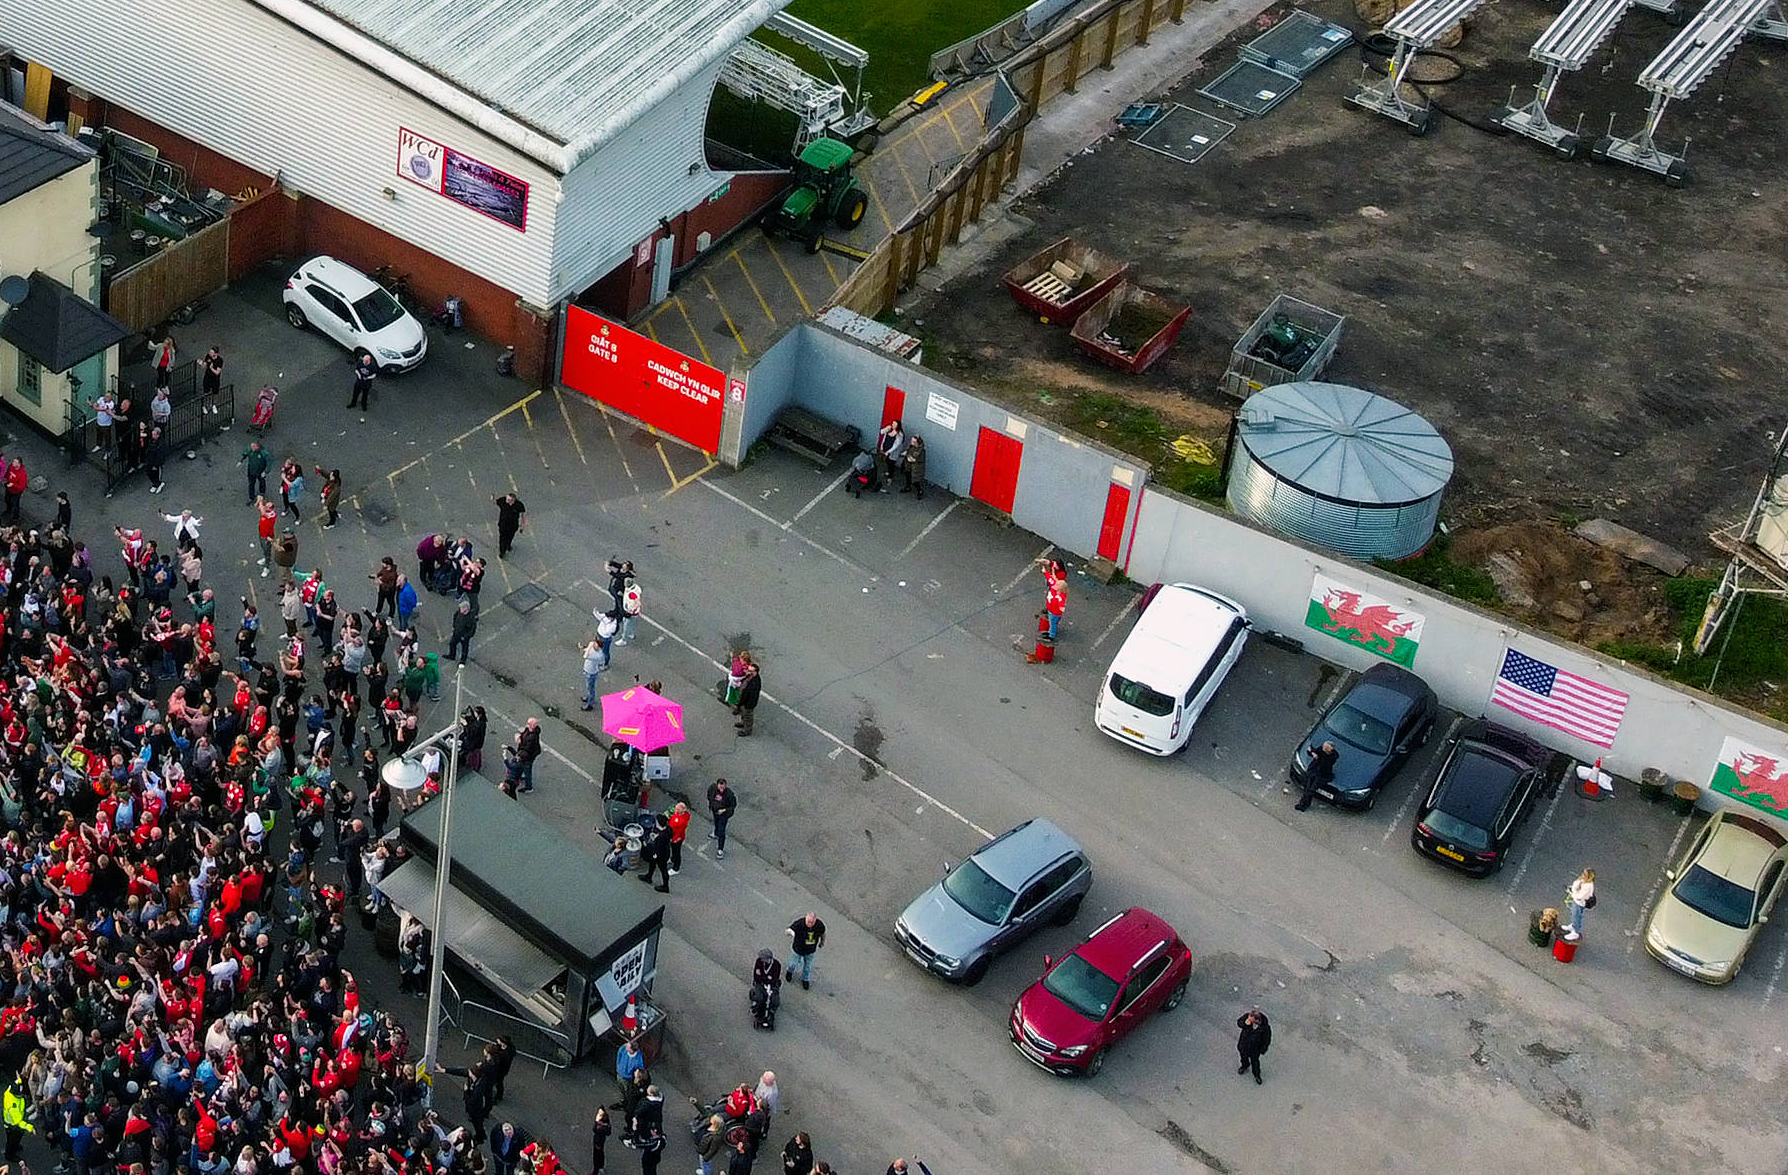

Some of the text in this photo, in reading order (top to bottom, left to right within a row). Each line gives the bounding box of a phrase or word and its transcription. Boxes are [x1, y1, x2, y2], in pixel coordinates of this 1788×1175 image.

[588, 344, 618, 363] GATE 8
[647, 360, 720, 399] CADWCH YN GLIR
[657, 374, 708, 405] KEEP CLEAR
[733, 387, 742, 401] 8
[613, 952, 643, 982] OPEN
[617, 964, 642, 989] AILY
